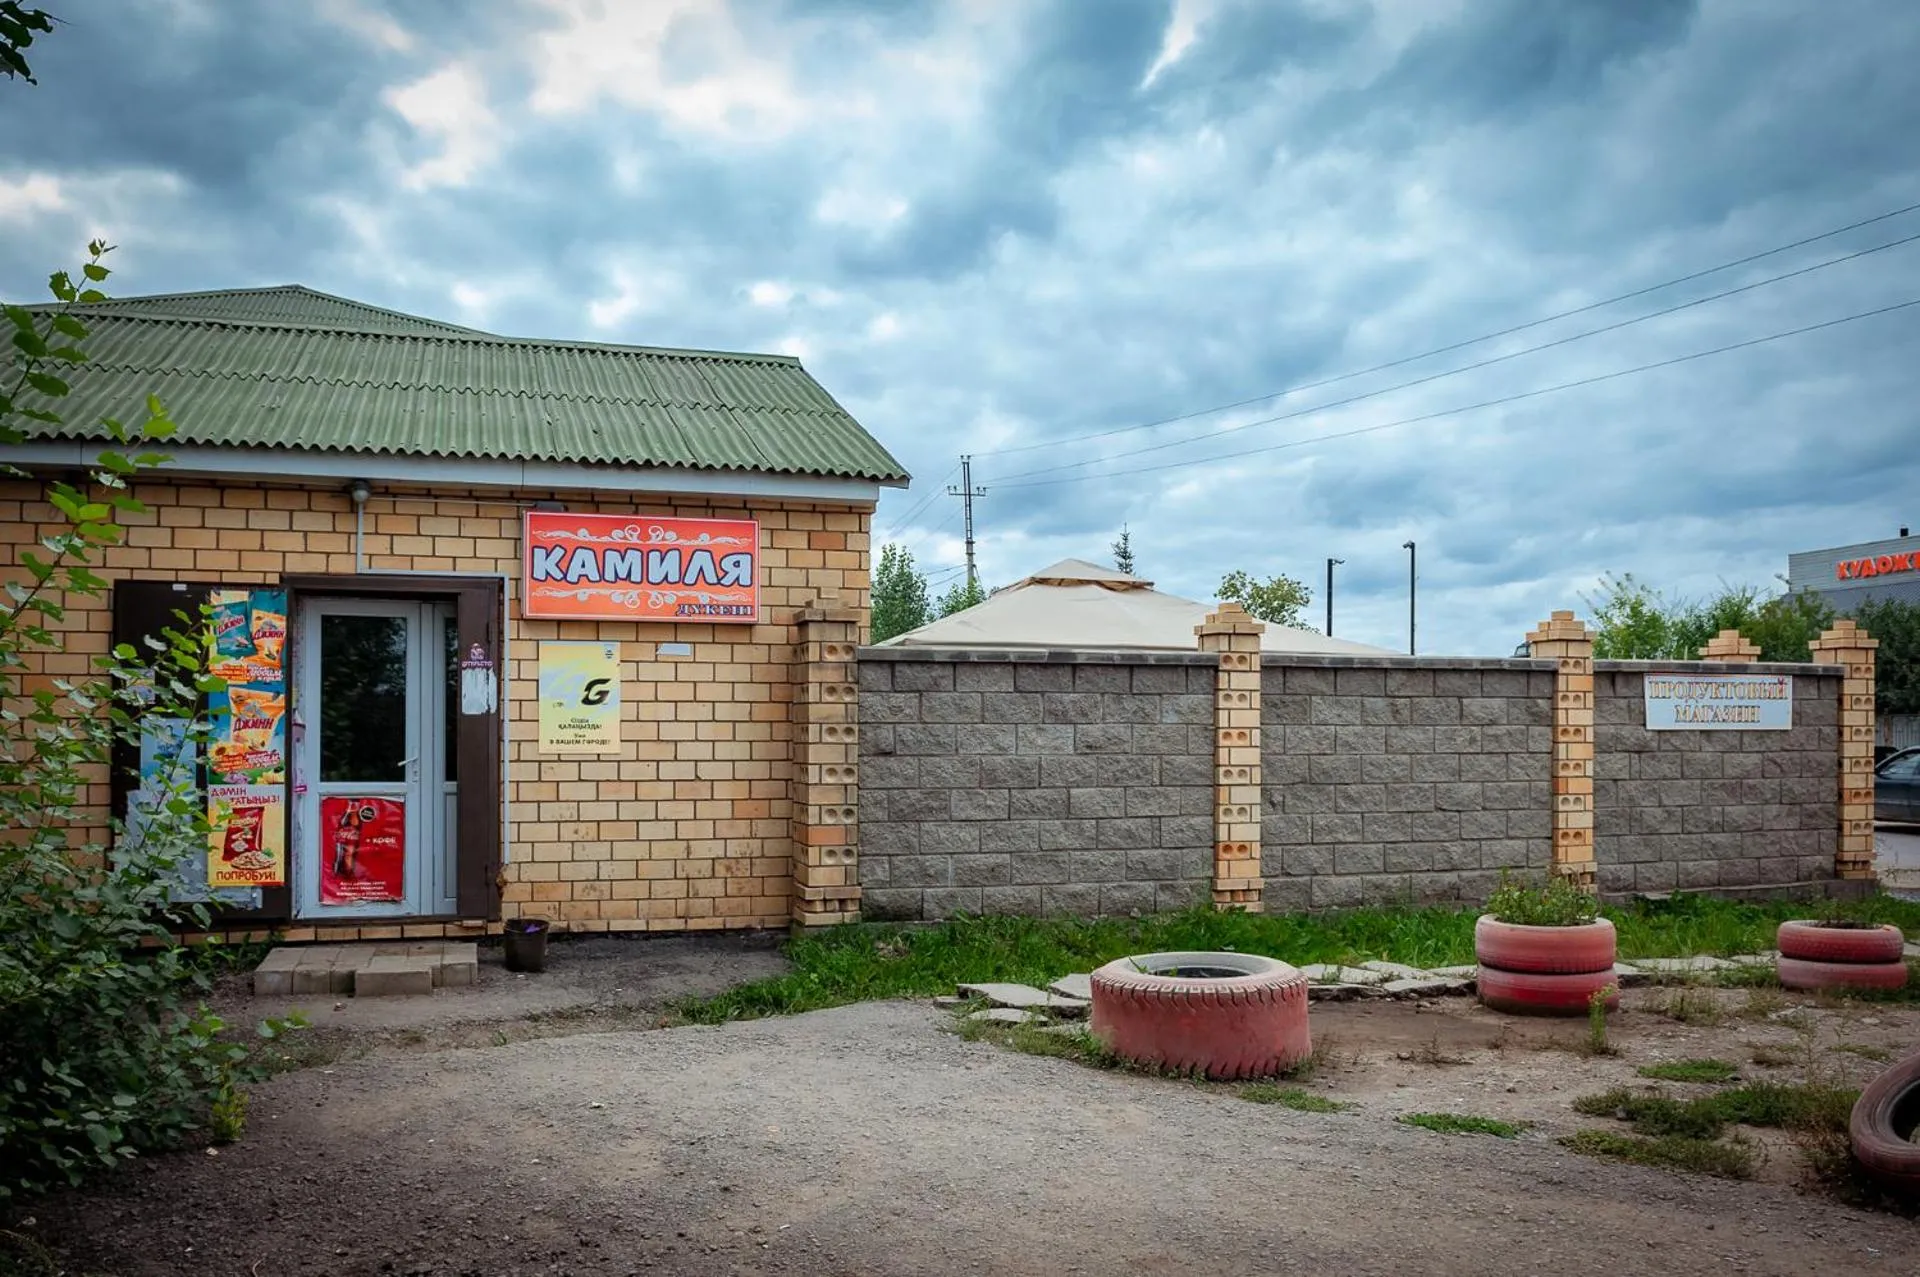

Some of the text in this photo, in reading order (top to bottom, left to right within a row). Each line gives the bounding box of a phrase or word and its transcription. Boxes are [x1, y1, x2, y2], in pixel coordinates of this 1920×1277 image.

[531, 545, 753, 587] КАМИЛЯ
[1648, 677, 1789, 702] ПРОДУКТОВЫЙ
[1674, 704, 1761, 723] МАГАЗИН
